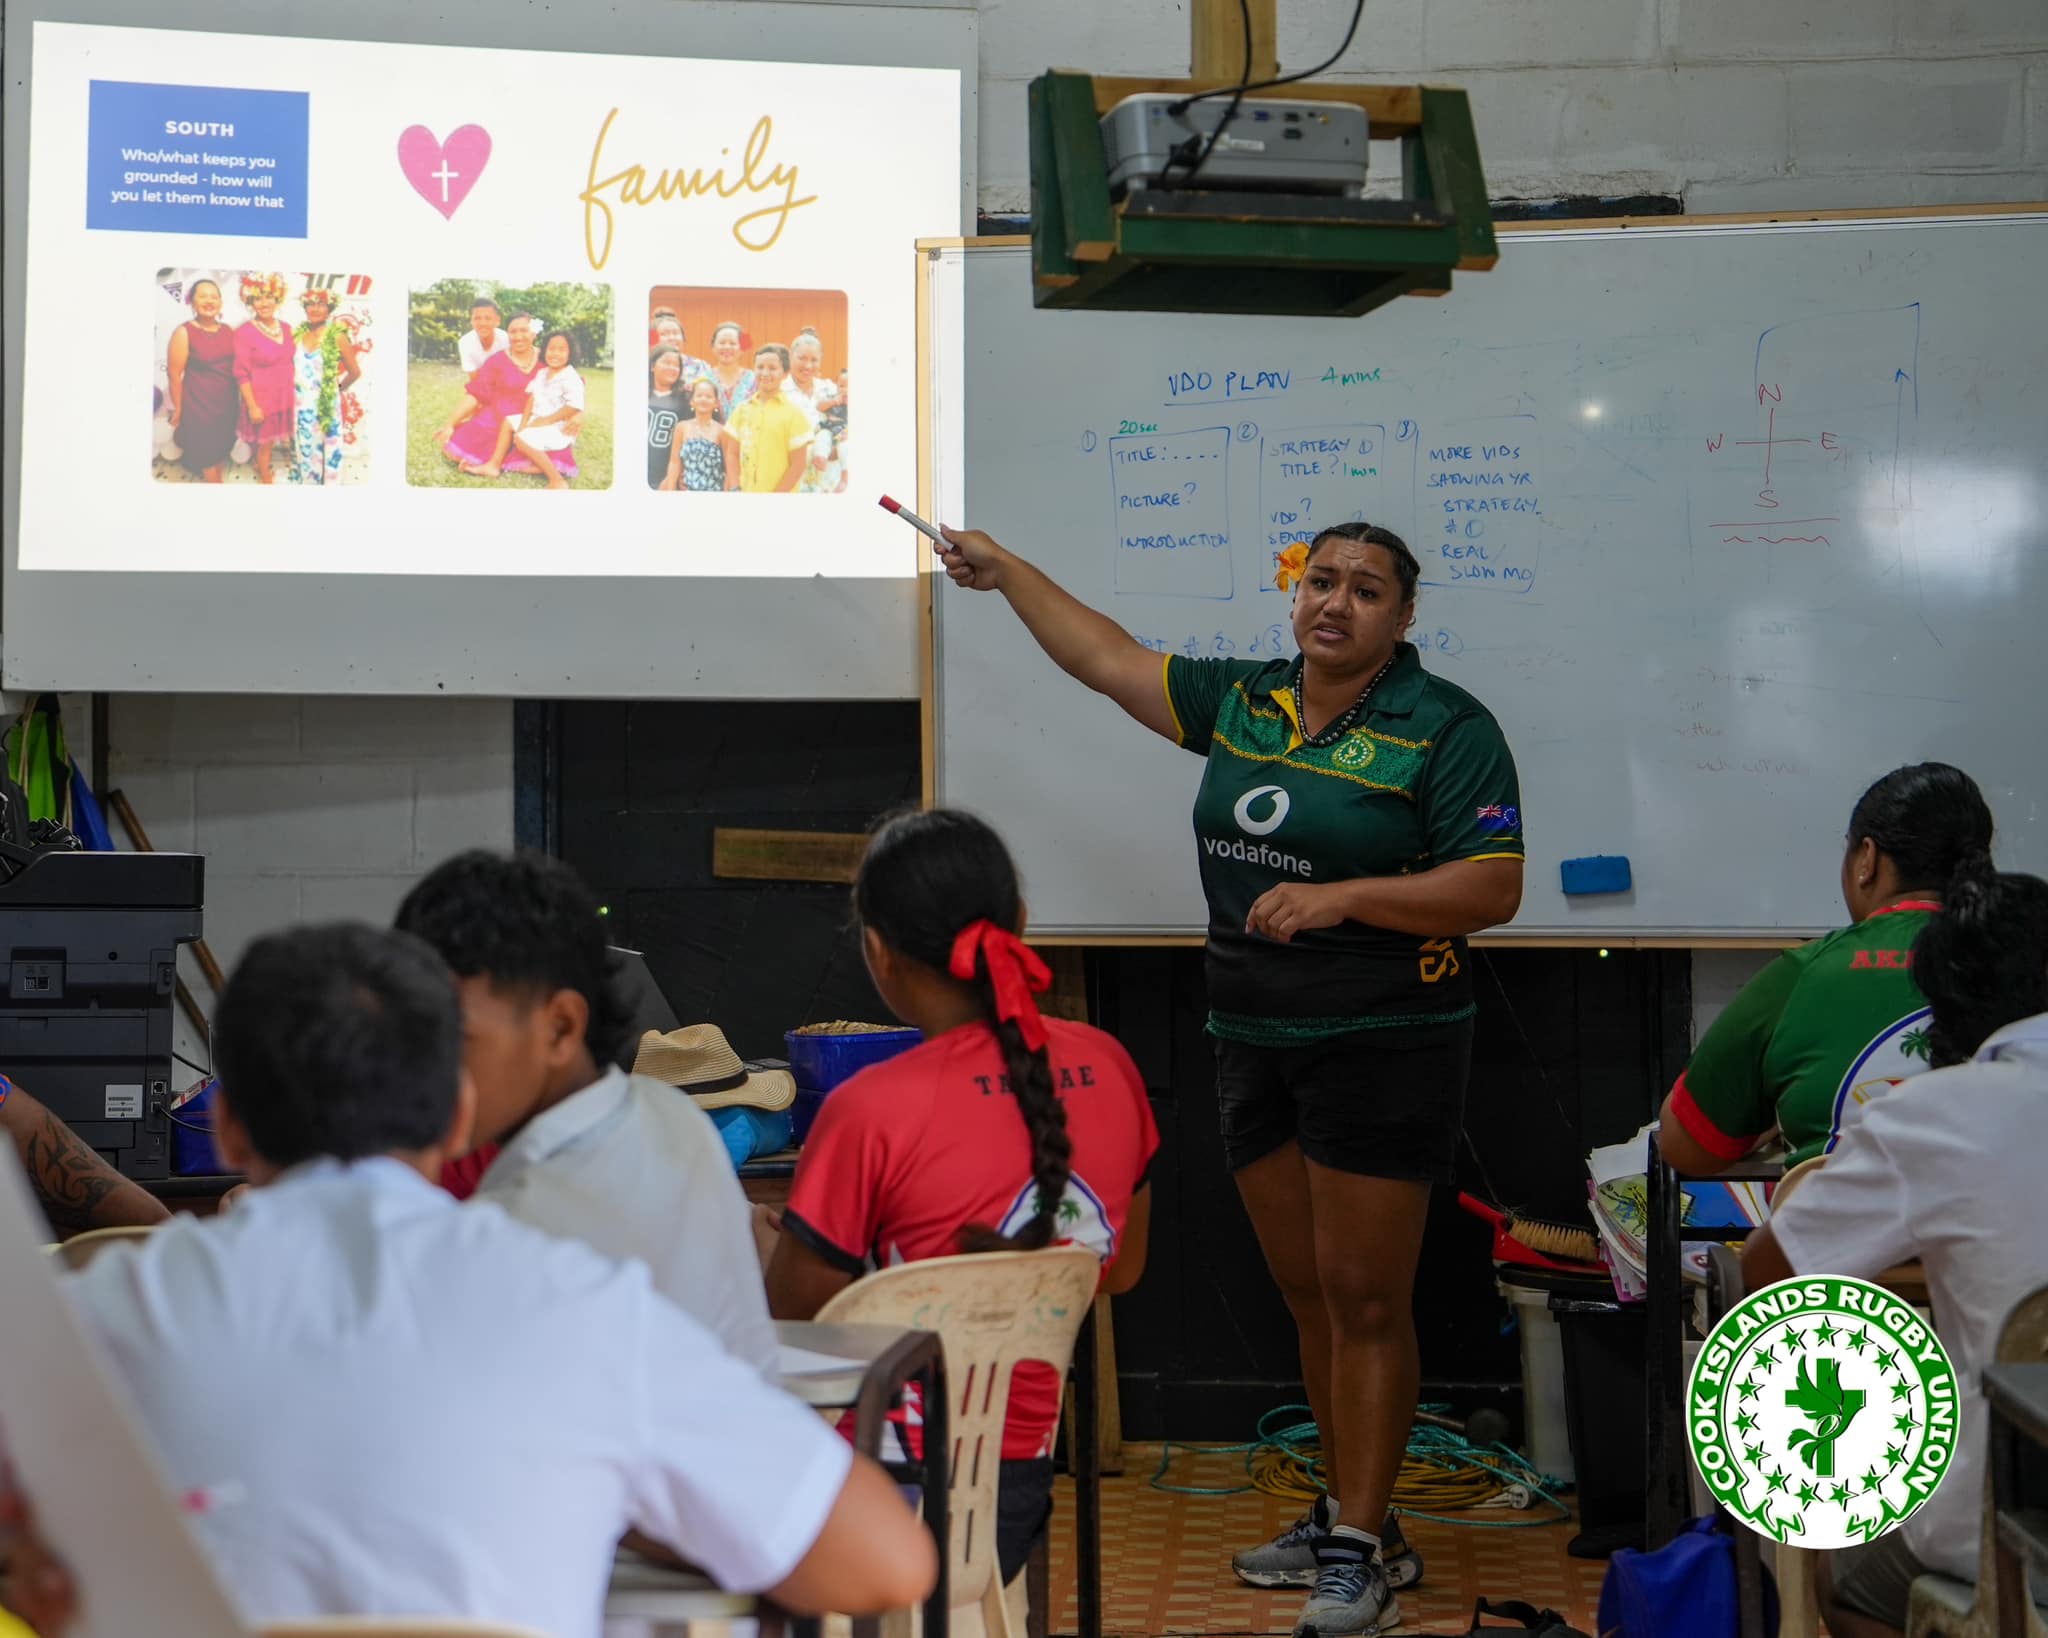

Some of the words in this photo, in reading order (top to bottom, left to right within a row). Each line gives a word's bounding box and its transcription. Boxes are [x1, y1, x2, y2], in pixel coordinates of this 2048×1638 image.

[165, 120, 235, 137] SOUTH
[121, 148, 199, 164] Who/what
[203, 152, 246, 168] keeps
[248, 156, 276, 170] you
[124, 171, 198, 185] grounded
[211, 174, 243, 187] how
[246, 176, 273, 188] will
[579, 107, 819, 271] family
[111, 189, 138, 203] you
[143, 190, 162, 203] let
[166, 192, 206, 205] them
[210, 194, 250, 207] know
[254, 196, 285, 208] that
[1168, 371, 1212, 396] VDO
[1226, 370, 1290, 396] PLAN
[1758, 383, 1781, 405] N
[1269, 438, 1350, 456] STRATEGY
[1706, 433, 1723, 453] W
[1821, 431, 1839, 450] E
[1429, 446, 1473, 461] MORE
[1754, 489, 1779, 508] S
[1120, 533, 1228, 549] INTRODUCTION
[1451, 565, 1495, 580] SLOW
[1203, 837, 1312, 877] vodafone
